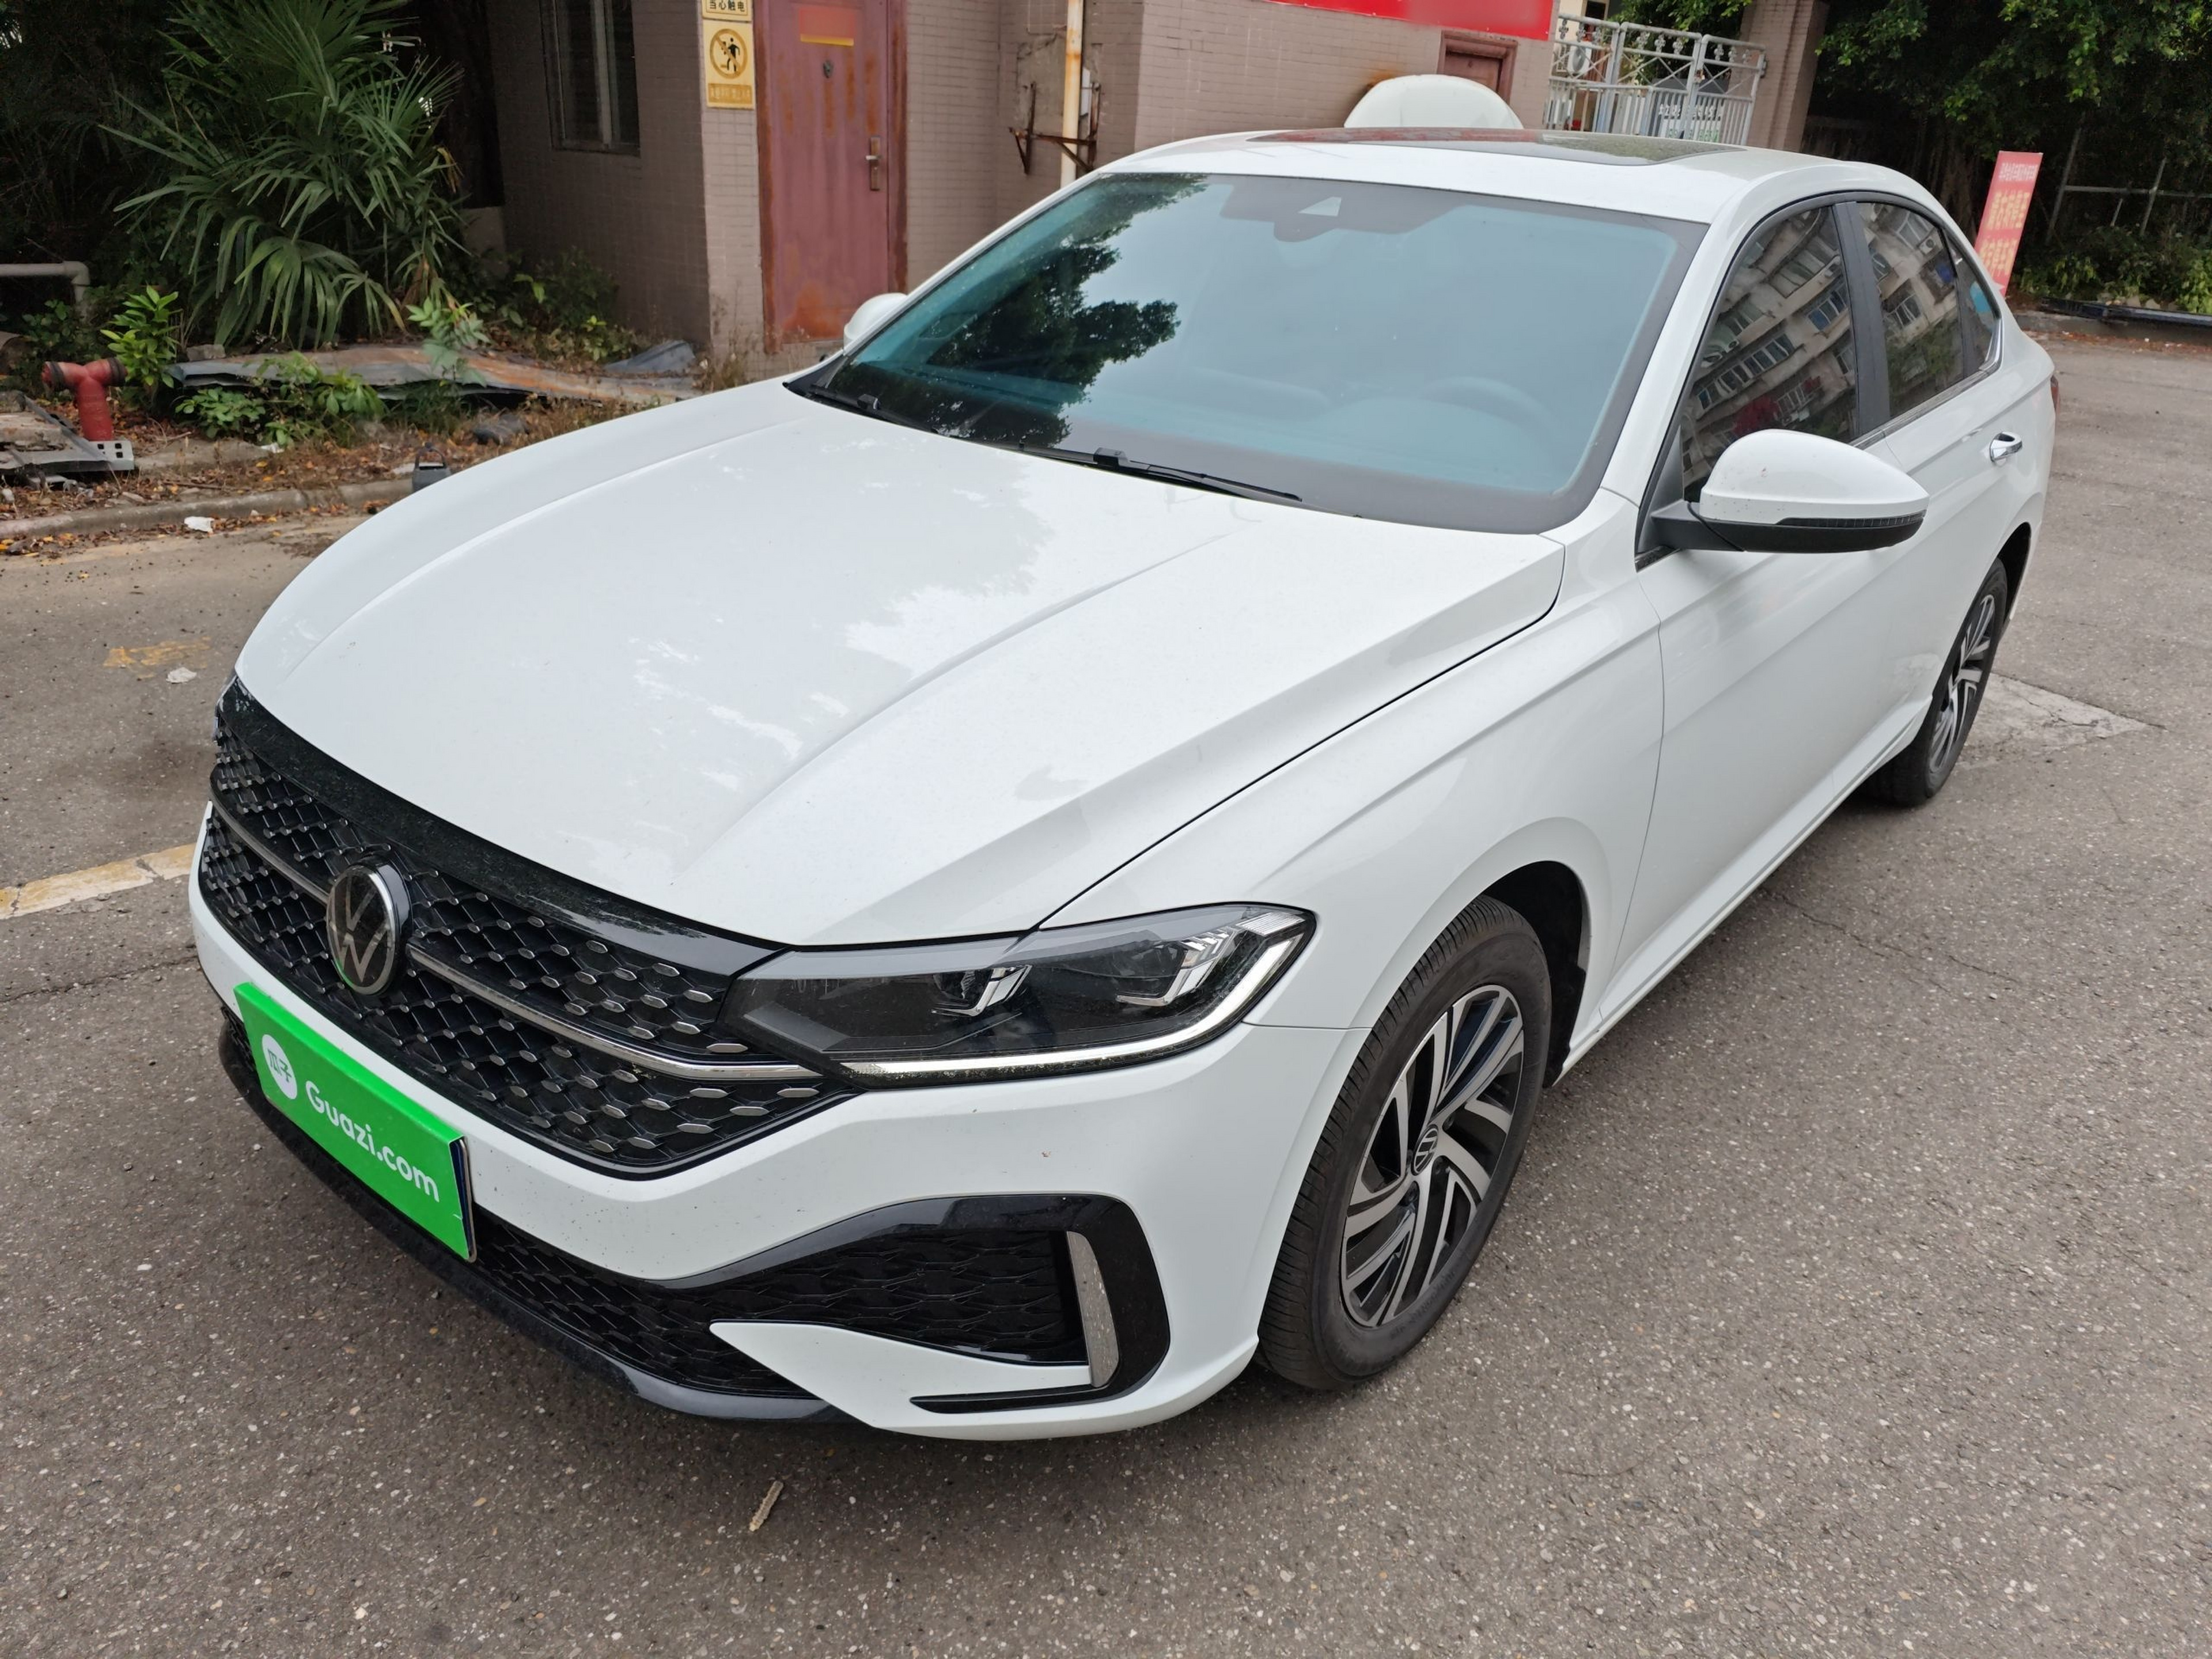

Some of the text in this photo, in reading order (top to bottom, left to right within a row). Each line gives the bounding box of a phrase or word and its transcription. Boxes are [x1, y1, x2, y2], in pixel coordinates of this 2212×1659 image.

[709, 0, 745, 12] 当心触电
[267, 1048, 292, 1083] 瓜子
[305, 1080, 440, 1203] Guazi.com
